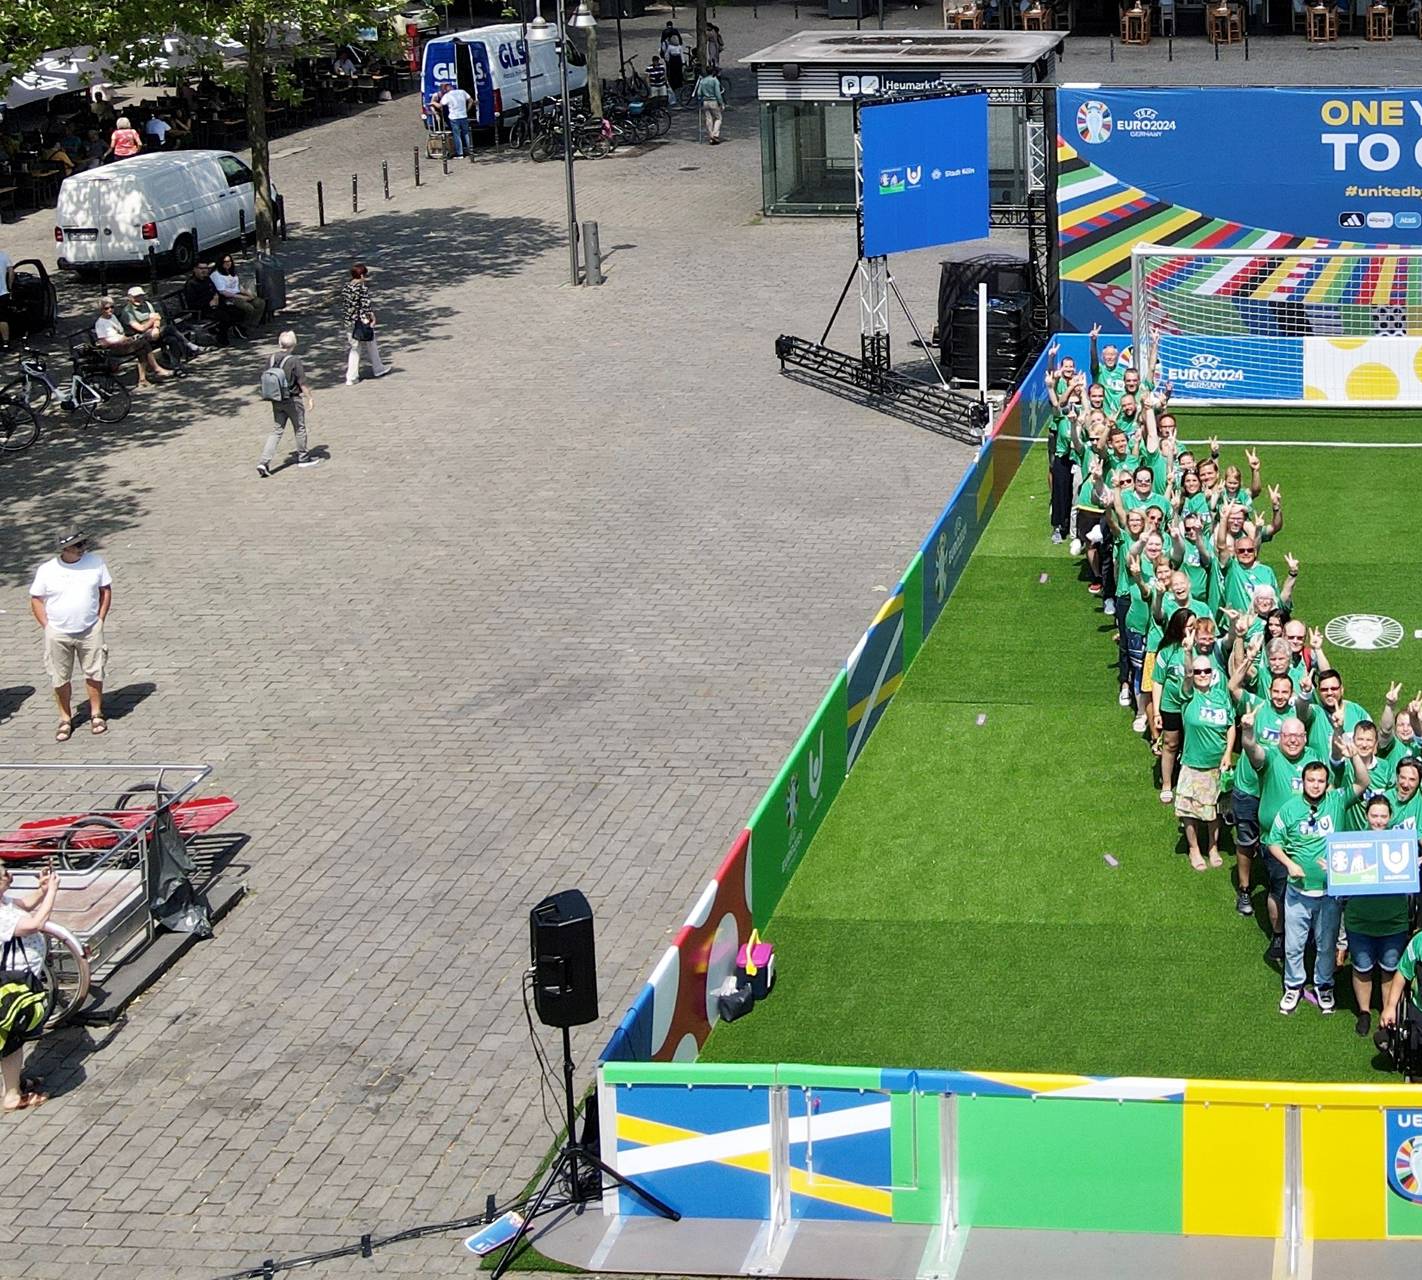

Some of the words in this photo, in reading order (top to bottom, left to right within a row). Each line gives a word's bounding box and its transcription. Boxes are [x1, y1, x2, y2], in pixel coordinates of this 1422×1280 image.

[1134, 107, 1158, 120] UEFA
[1320, 100, 1404, 126] ONE
[1117, 121, 1176, 130] EURO2024
[1321, 133, 1401, 172] TO
[1191, 353, 1221, 369] UEFA
[1168, 368, 1244, 380] EURO2024
[1184, 381, 1226, 389] GERMANY
